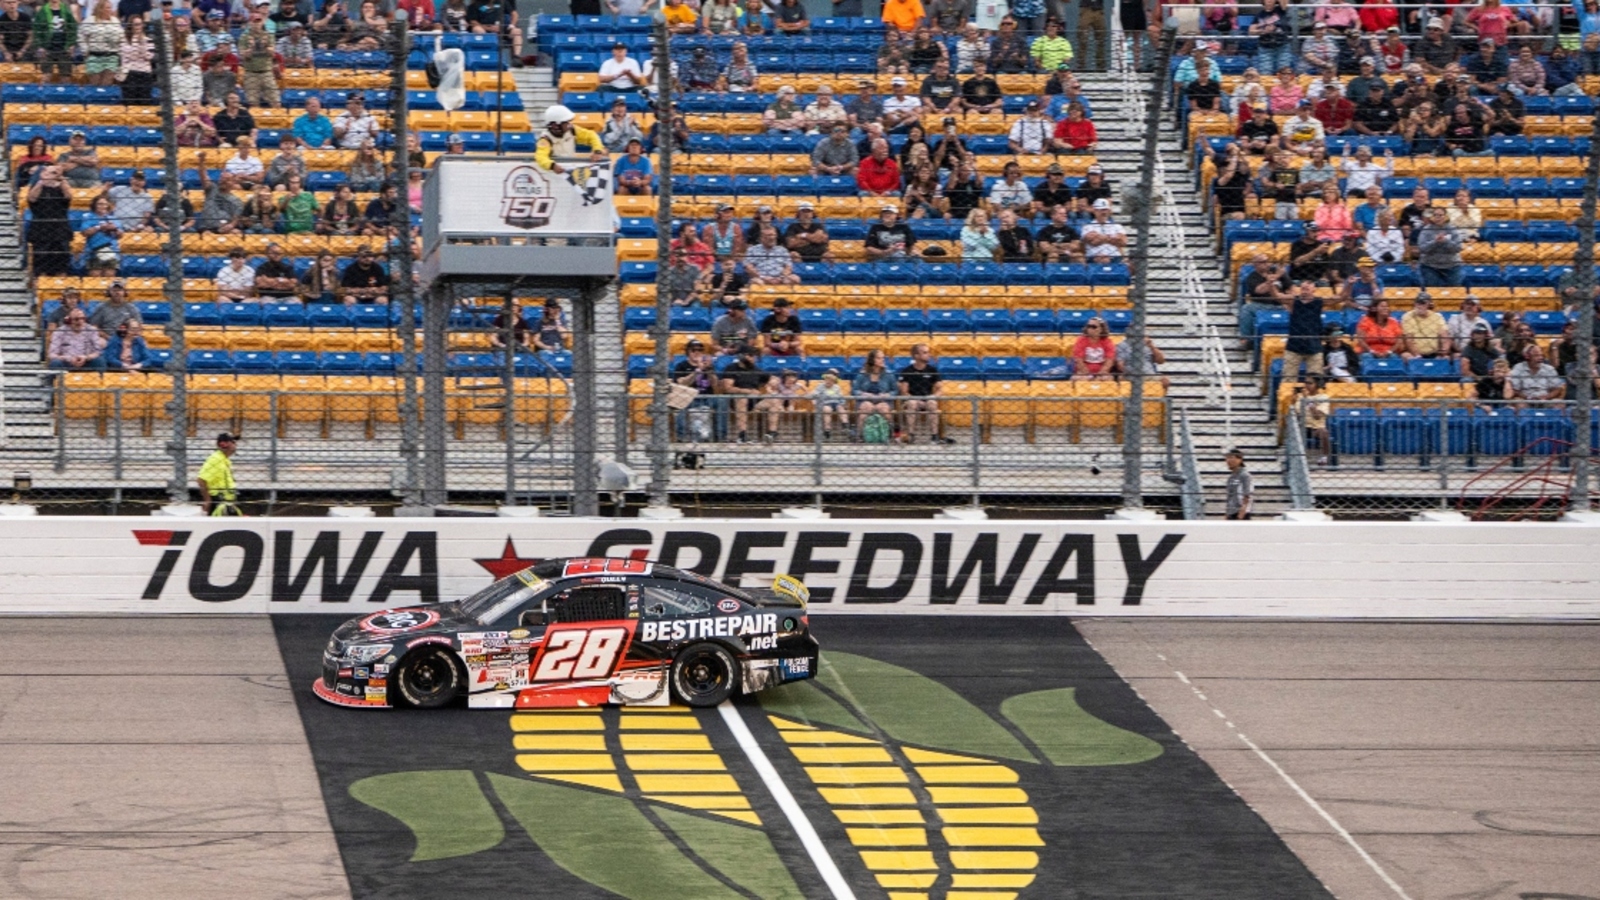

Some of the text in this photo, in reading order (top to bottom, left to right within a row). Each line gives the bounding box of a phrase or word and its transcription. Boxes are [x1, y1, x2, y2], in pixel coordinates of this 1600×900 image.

[499, 197, 558, 219] 150
[131, 529, 438, 603] IOWA
[641, 613, 778, 642] BESTREPAIR
[746, 632, 778, 651] .net
[530, 627, 628, 683] 28
